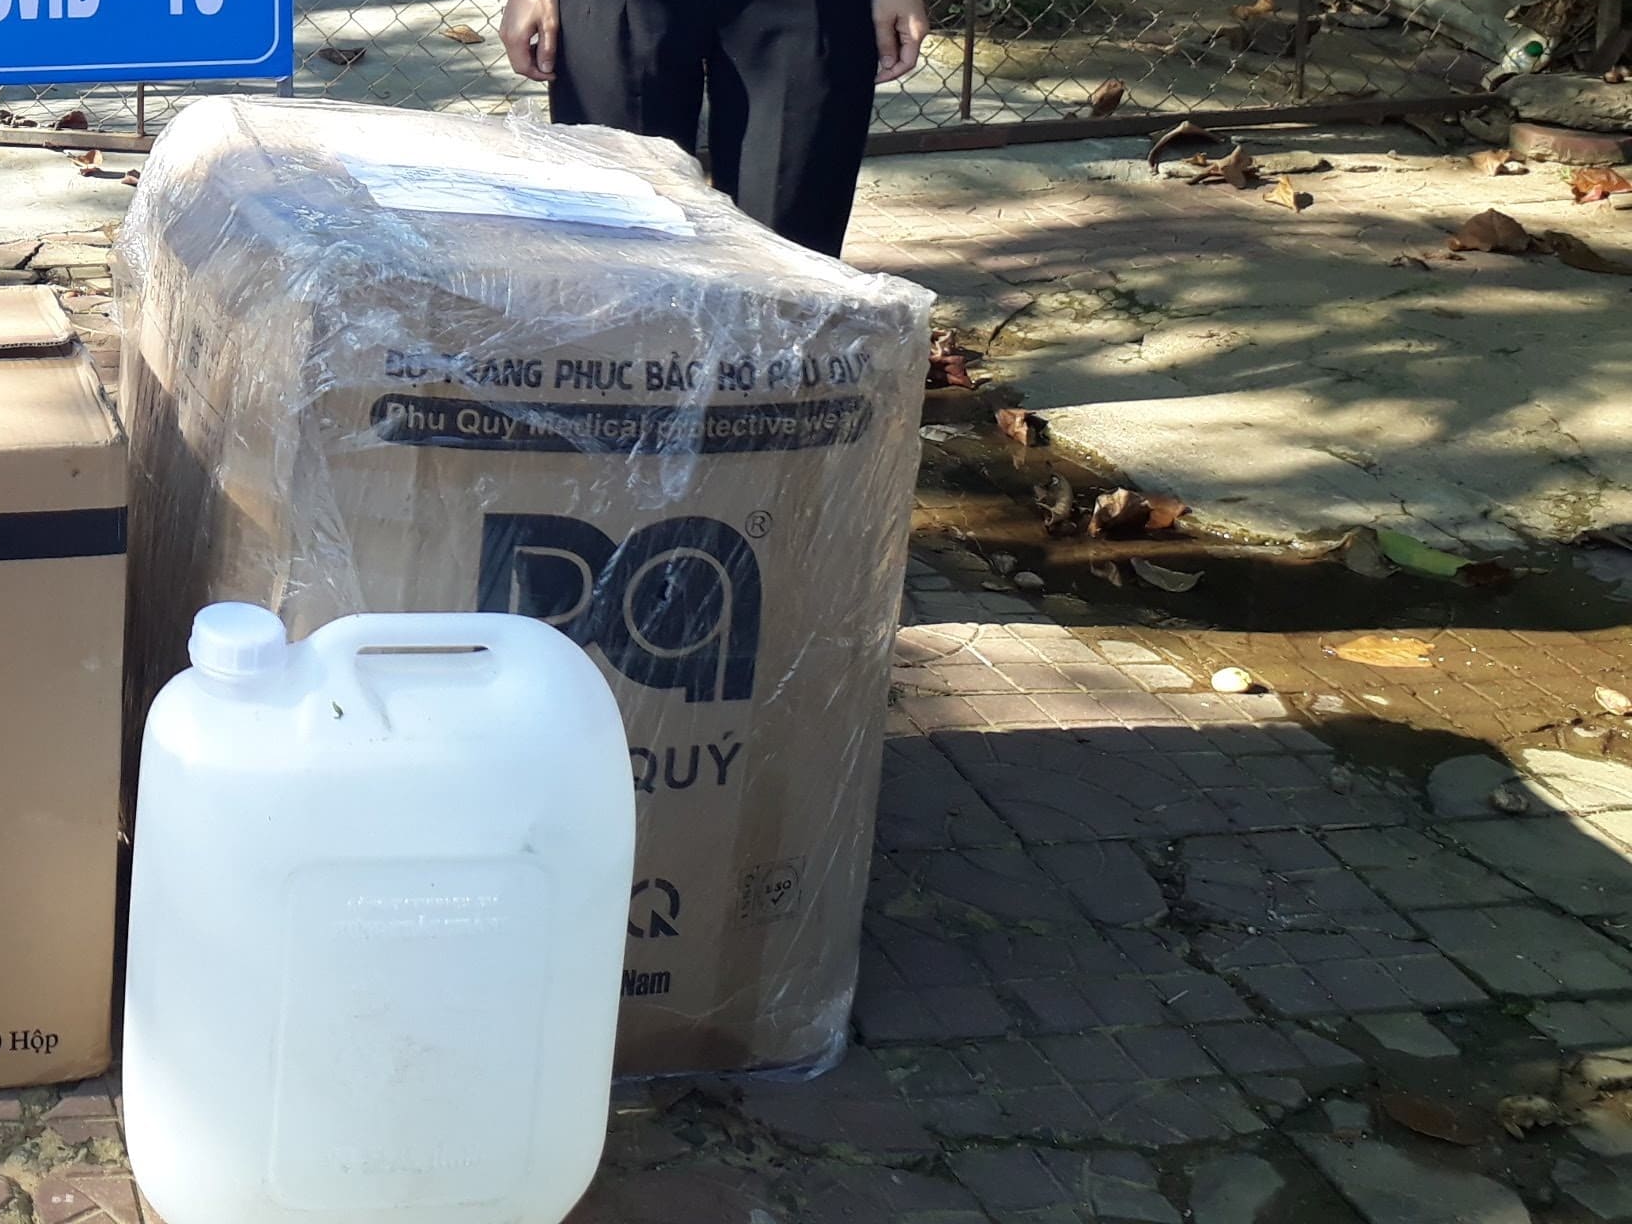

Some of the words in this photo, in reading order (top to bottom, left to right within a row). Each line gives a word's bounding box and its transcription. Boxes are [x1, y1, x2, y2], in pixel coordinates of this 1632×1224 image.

[554, 359, 633, 397] PHỤC
[385, 401, 445, 431] Phu
[457, 408, 517, 441] Quy
[629, 730, 743, 794] QUÝ
[621, 968, 671, 998] Nam
[9, 1029, 60, 1056] Hộp
